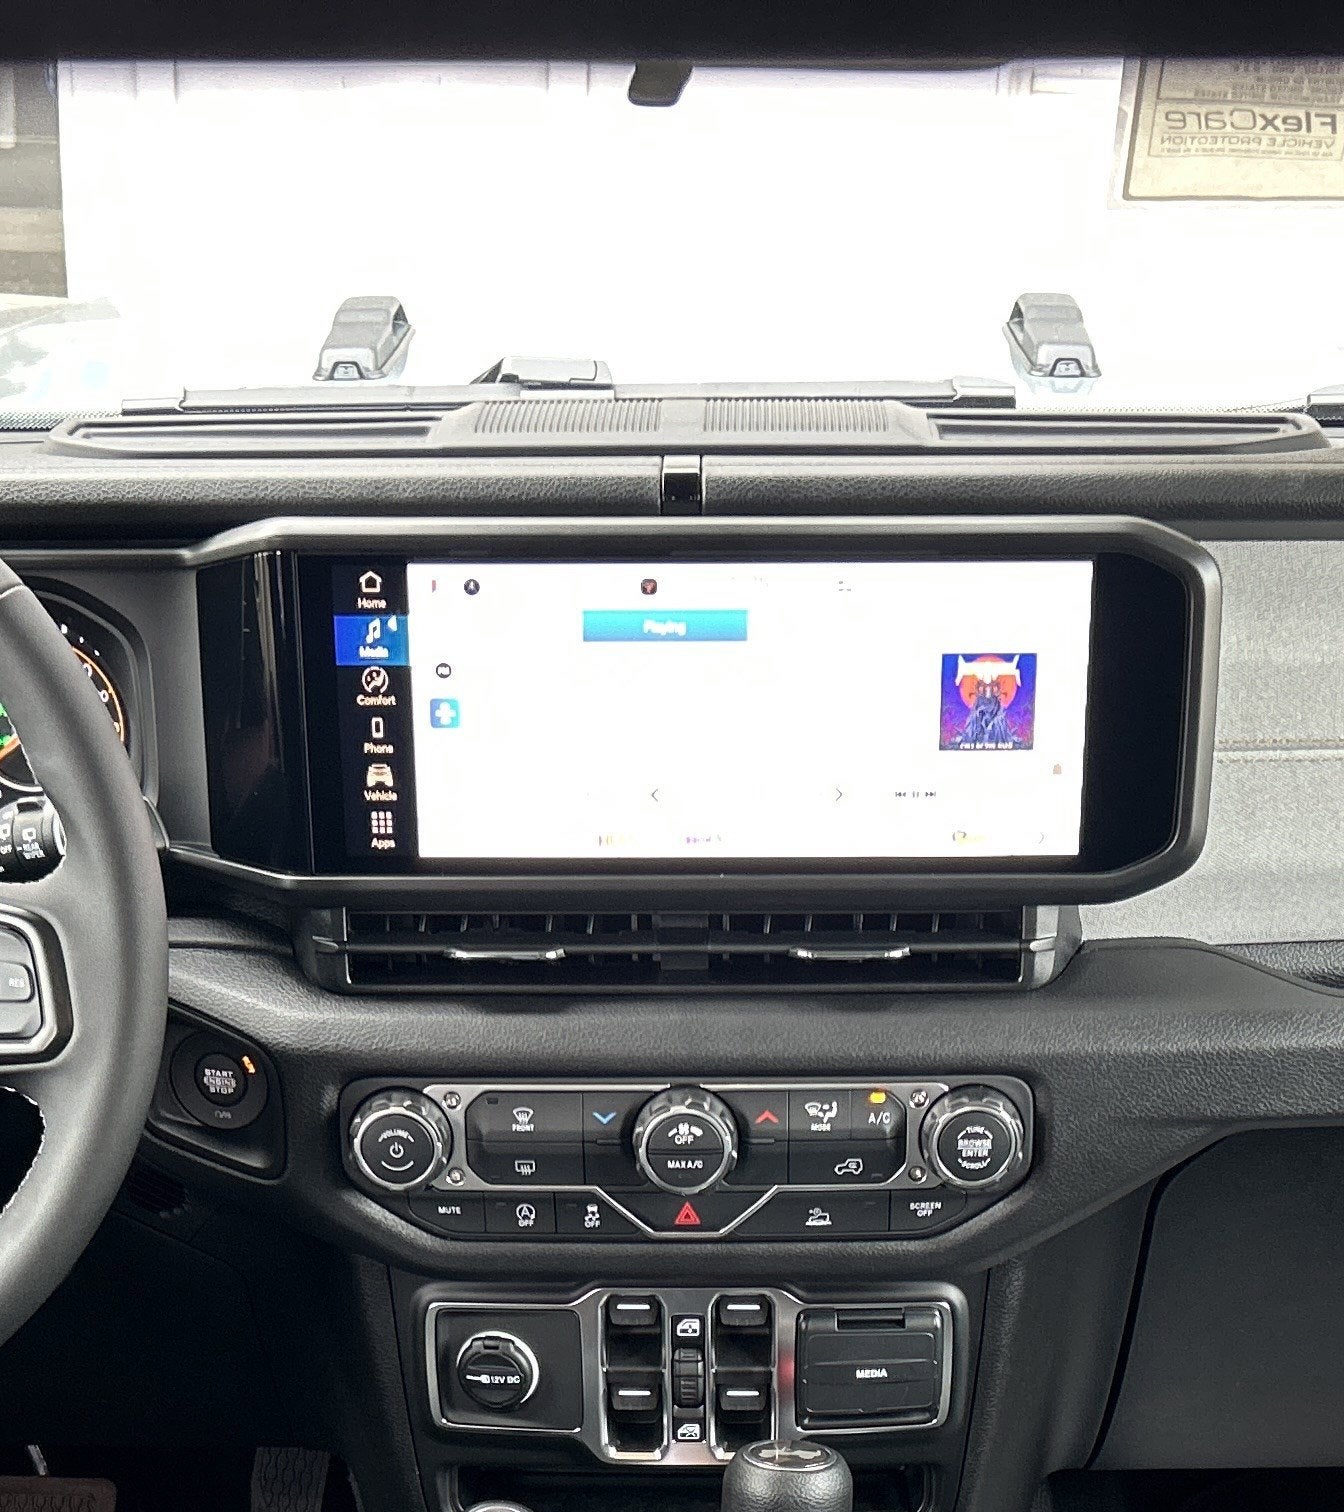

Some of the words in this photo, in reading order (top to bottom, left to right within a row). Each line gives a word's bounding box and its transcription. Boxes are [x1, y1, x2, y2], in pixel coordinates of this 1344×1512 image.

[357, 598, 387, 609] Home
[358, 646, 389, 659] Media
[356, 694, 396, 706] Comfort
[364, 743, 394, 754] Phone
[364, 790, 398, 802] Vehicle
[371, 837, 396, 850] Apps
[8, 978, 25, 988] RES
[204, 1068, 233, 1078] START
[203, 1076, 237, 1088] ENGINE
[209, 1086, 234, 1094] STOP
[868, 1112, 891, 1125] A/C
[512, 1123, 535, 1132] FRONT
[810, 1122, 831, 1132] MODE
[674, 1135, 694, 1145] OFF
[957, 1139, 992, 1150] BROWSE
[962, 1149, 988, 1157] ENTER
[667, 1160, 687, 1169] MAX
[687, 1160, 703, 1169] A/C
[438, 1206, 461, 1215] MUTE
[909, 1202, 942, 1210] SCREEN
[916, 1209, 933, 1217] OFF
[518, 1219, 534, 1228] OFF
[584, 1219, 601, 1228] OFF
[856, 1368, 888, 1379] MEDIA
